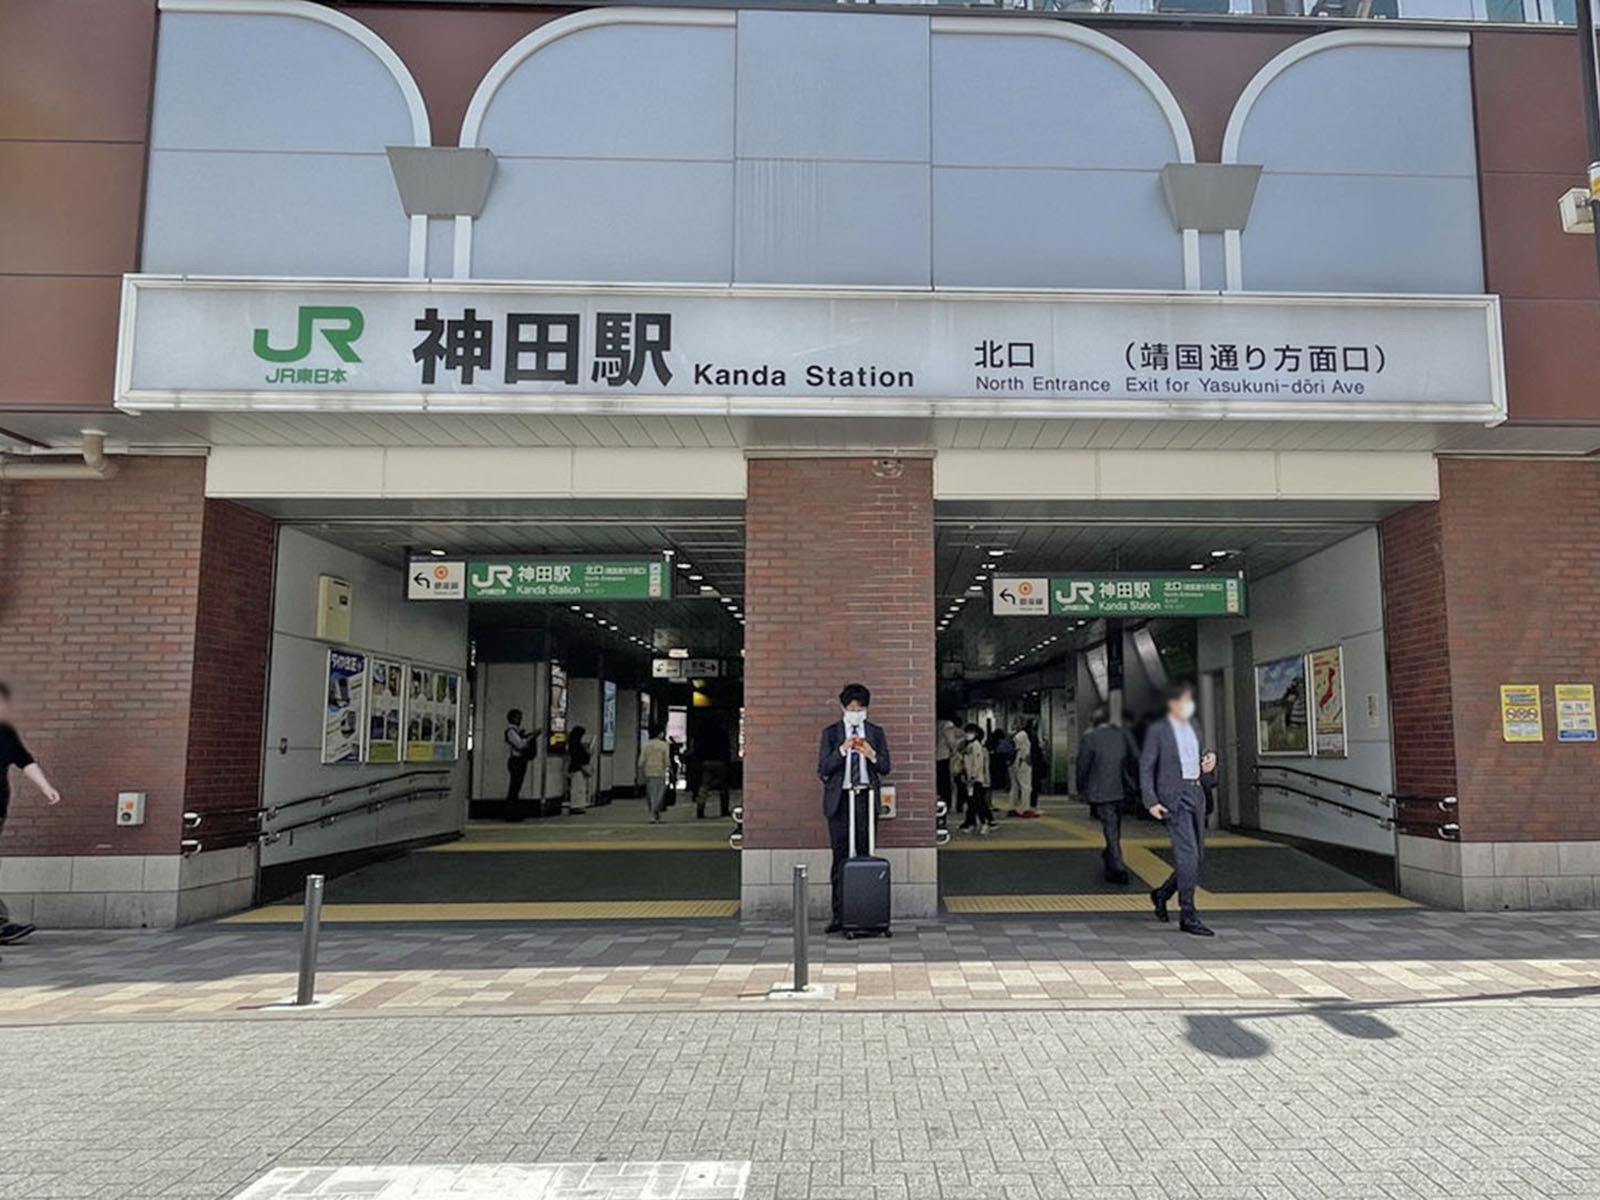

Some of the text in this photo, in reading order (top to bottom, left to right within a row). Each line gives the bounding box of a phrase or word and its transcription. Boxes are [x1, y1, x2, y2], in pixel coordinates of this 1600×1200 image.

[253, 306, 364, 363] JR
[412, 307, 673, 387] 神田駅
[974, 340, 1035, 369] 北口
[265, 367, 348, 385] JR東日本
[694, 363, 914, 388] Kanda Station
[976, 376, 1110, 392] North Entrance
[1126, 377, 1365, 395] Exit for Yasukuni-dōri Ave
[471, 565, 513, 588] JR
[518, 565, 571, 582] 神田駅
[516, 585, 547, 595] Kanda
[548, 585, 581, 595] Station
[1055, 581, 1094, 604] JR
[1099, 581, 1151, 598] 神田駅
[1099, 602, 1128, 611] Kanda
[1130, 601, 1161, 611] Station
